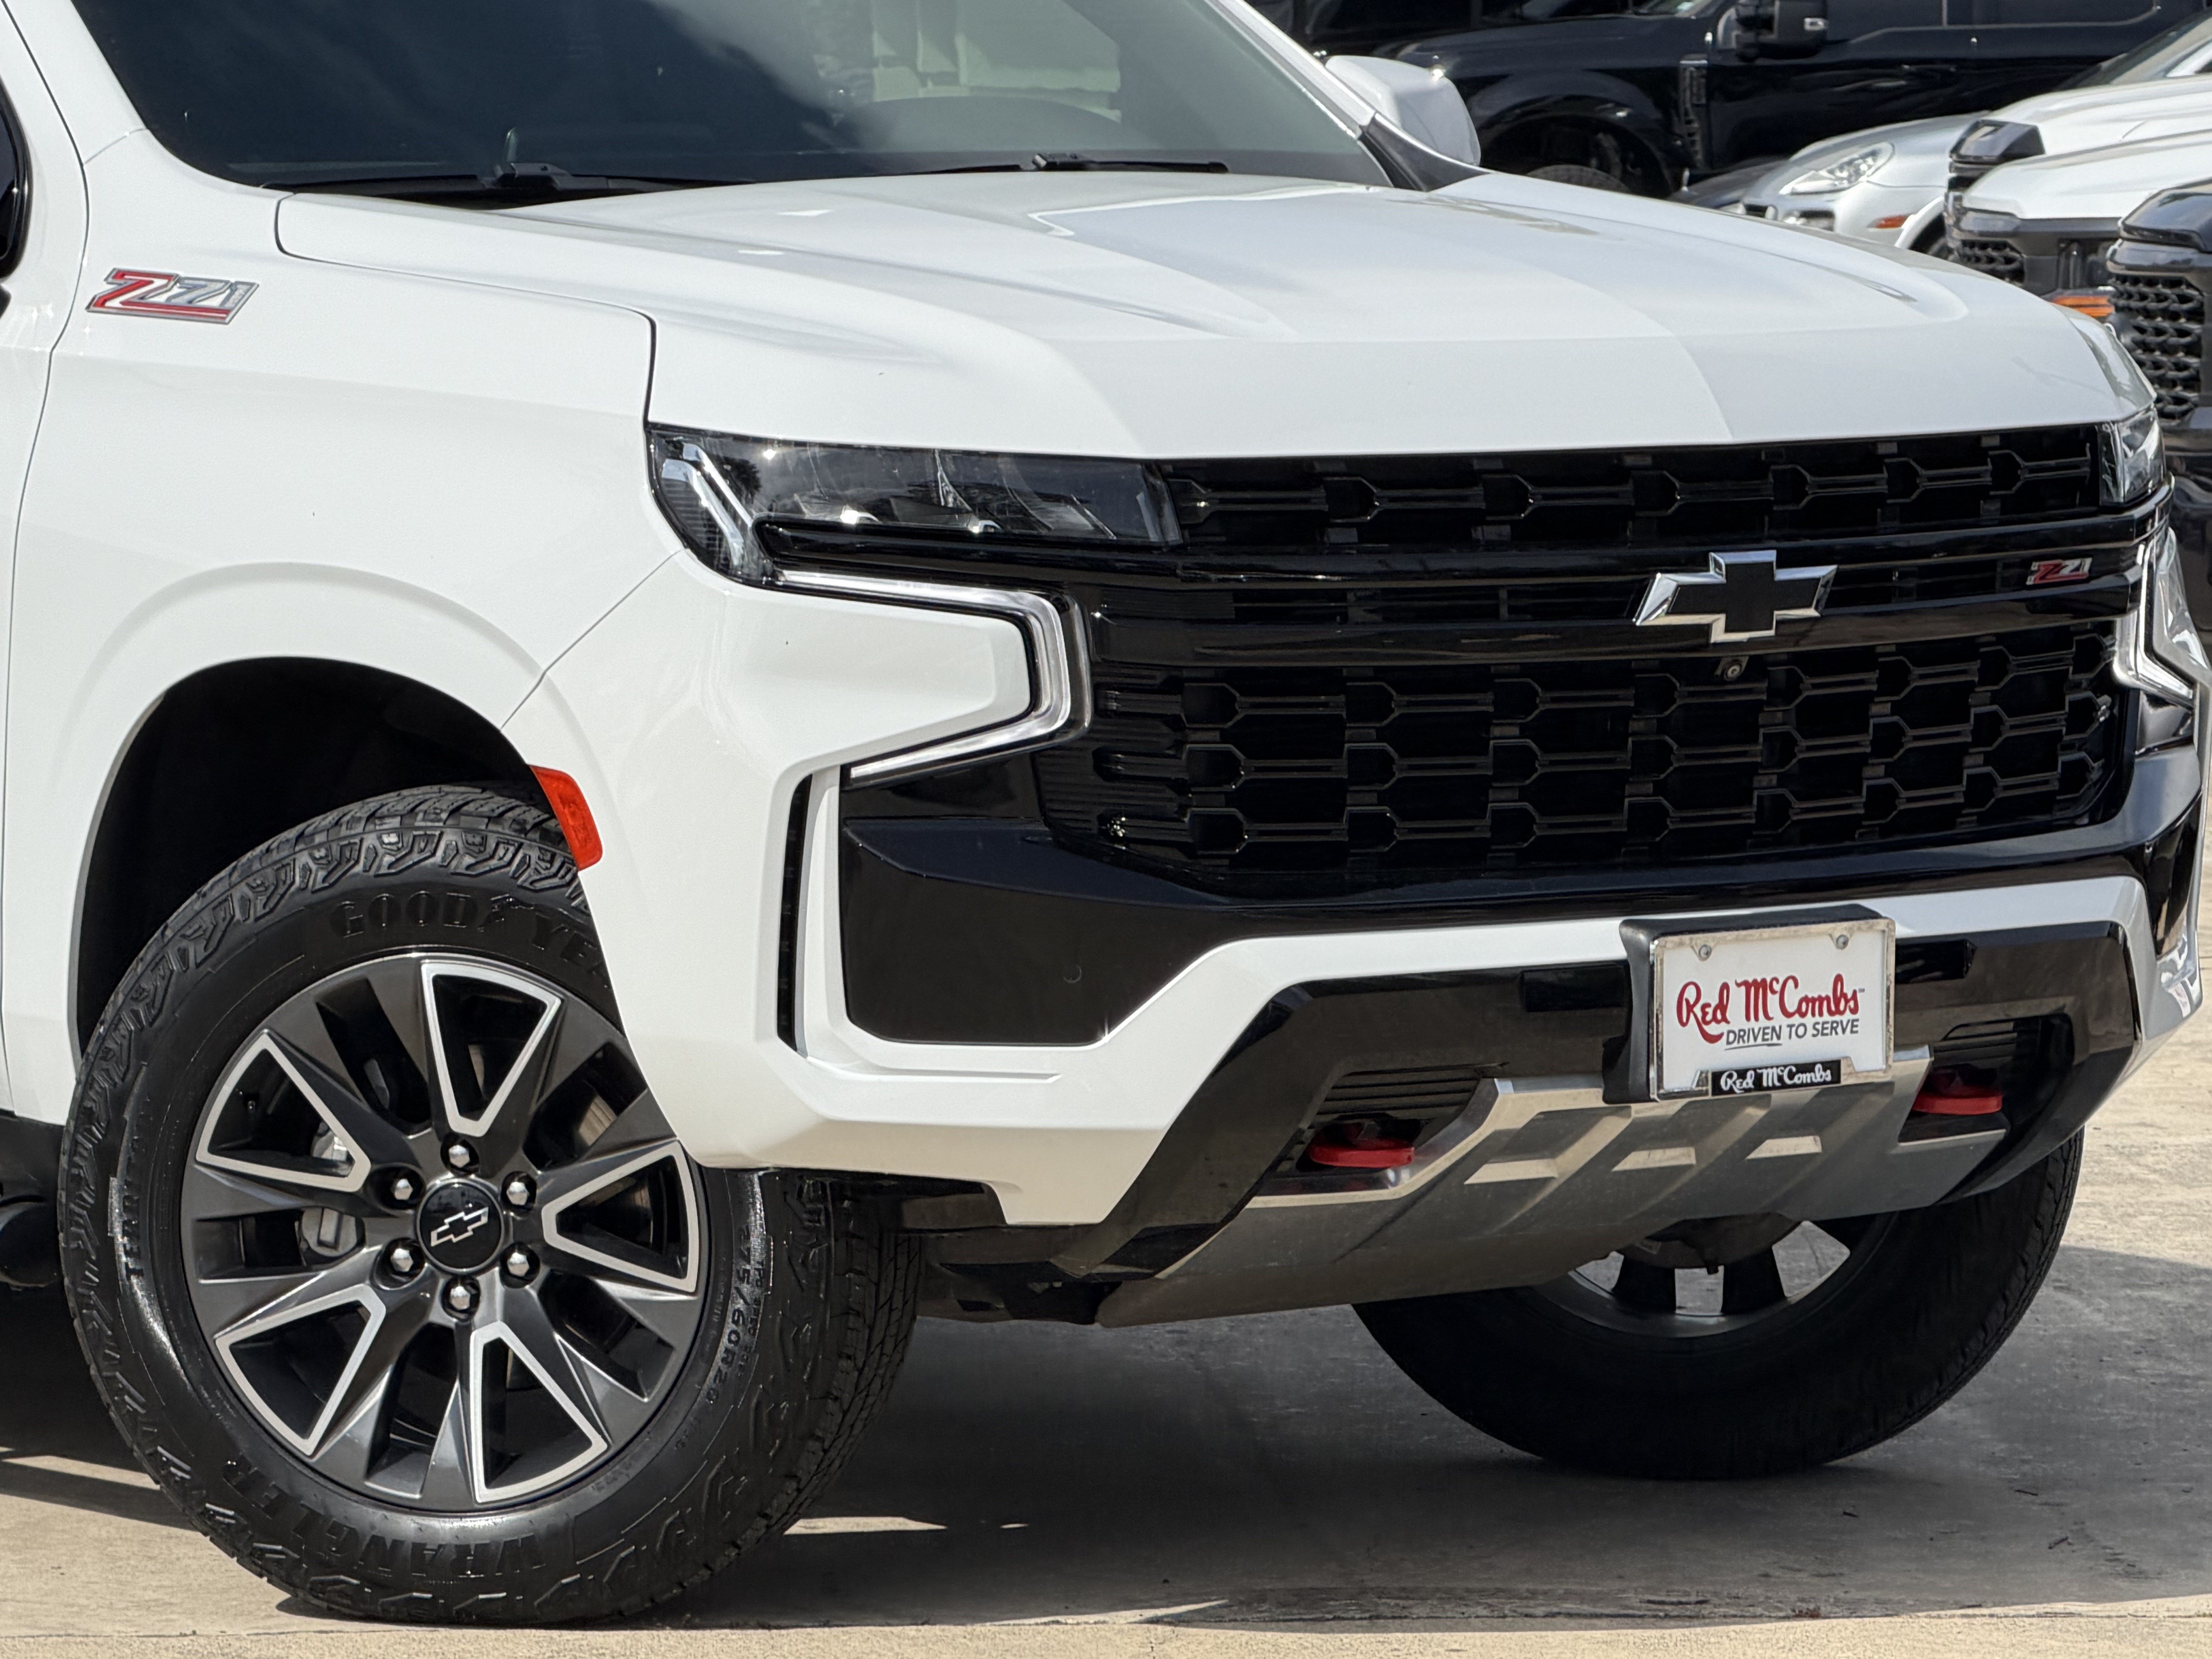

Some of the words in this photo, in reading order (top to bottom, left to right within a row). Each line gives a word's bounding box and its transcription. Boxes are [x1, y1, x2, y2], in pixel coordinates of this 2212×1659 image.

[85, 268, 259, 325] Z71
[2026, 557, 2092, 586] Z71
[1676, 981, 1731, 1043] Red
[1735, 974, 1860, 1022] McCombs
[1726, 1024, 1782, 1045] DRIVEN
[1786, 1022, 1807, 1039] TO
[1811, 1018, 1860, 1036] SERVE
[1720, 1071, 1755, 1093] Red
[1757, 1063, 1832, 1087] McCombs
